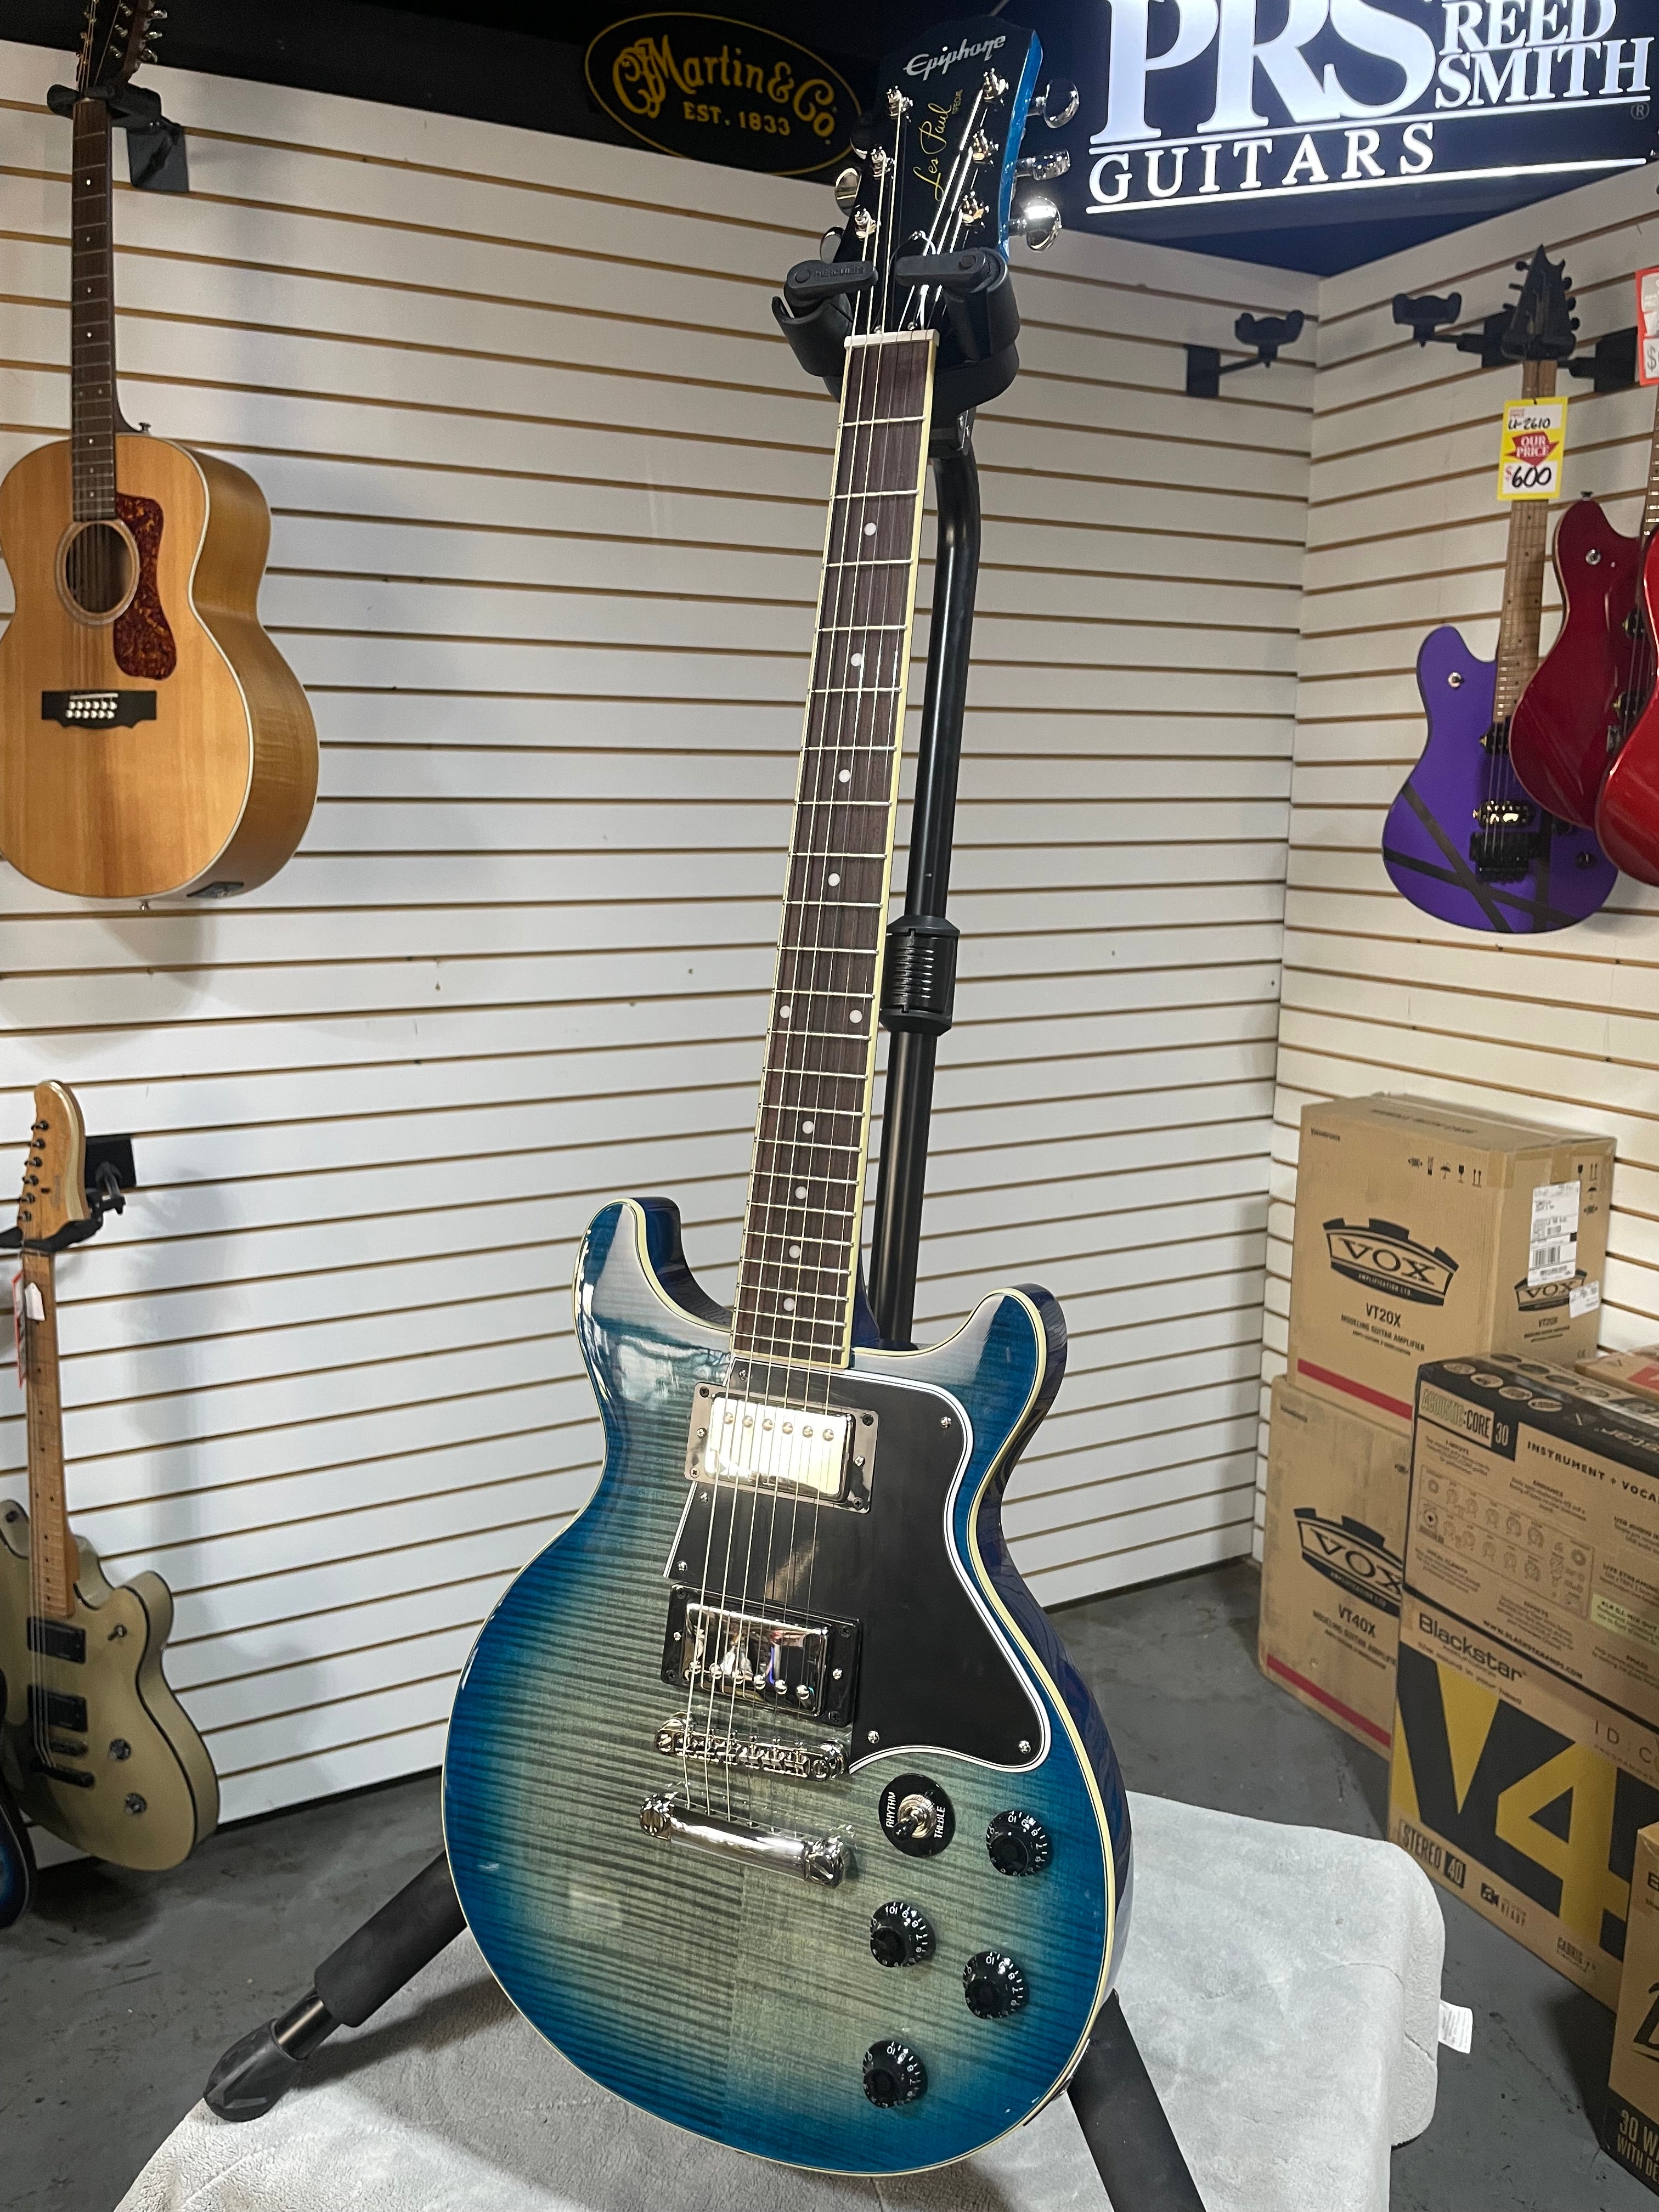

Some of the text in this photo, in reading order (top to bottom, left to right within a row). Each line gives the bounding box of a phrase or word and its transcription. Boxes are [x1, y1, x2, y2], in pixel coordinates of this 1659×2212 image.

[1439, 0, 1616, 55] REED
[903, 36, 1006, 81] Epiphone
[1090, 0, 1436, 144] PRS
[1435, 37, 1655, 109] SMITH
[739, 111, 790, 136] 1833
[1089, 122, 1434, 204] GUITARS
[1516, 445, 1550, 458] PRICE
[1521, 435, 1547, 448] OUR
[1339, 1237, 1436, 1285] VOX
[1366, 1302, 1402, 1329] VT20X
[1495, 1421, 1509, 1447] 30
[1527, 1441, 1605, 1481] INSTRUMENT
[1622, 1481, 1659, 1504] VOCA
[1310, 1527, 1402, 1594] VOX
[1339, 1604, 1376, 1639] VT40X
[1419, 1612, 1522, 1681] Blackstar
[885, 1791, 896, 1828] RHYTHM
[1401, 1822, 1464, 1884] STEREO 40
[1620, 2109, 1639, 2143] 30
[1617, 2133, 1644, 2170] WITH
